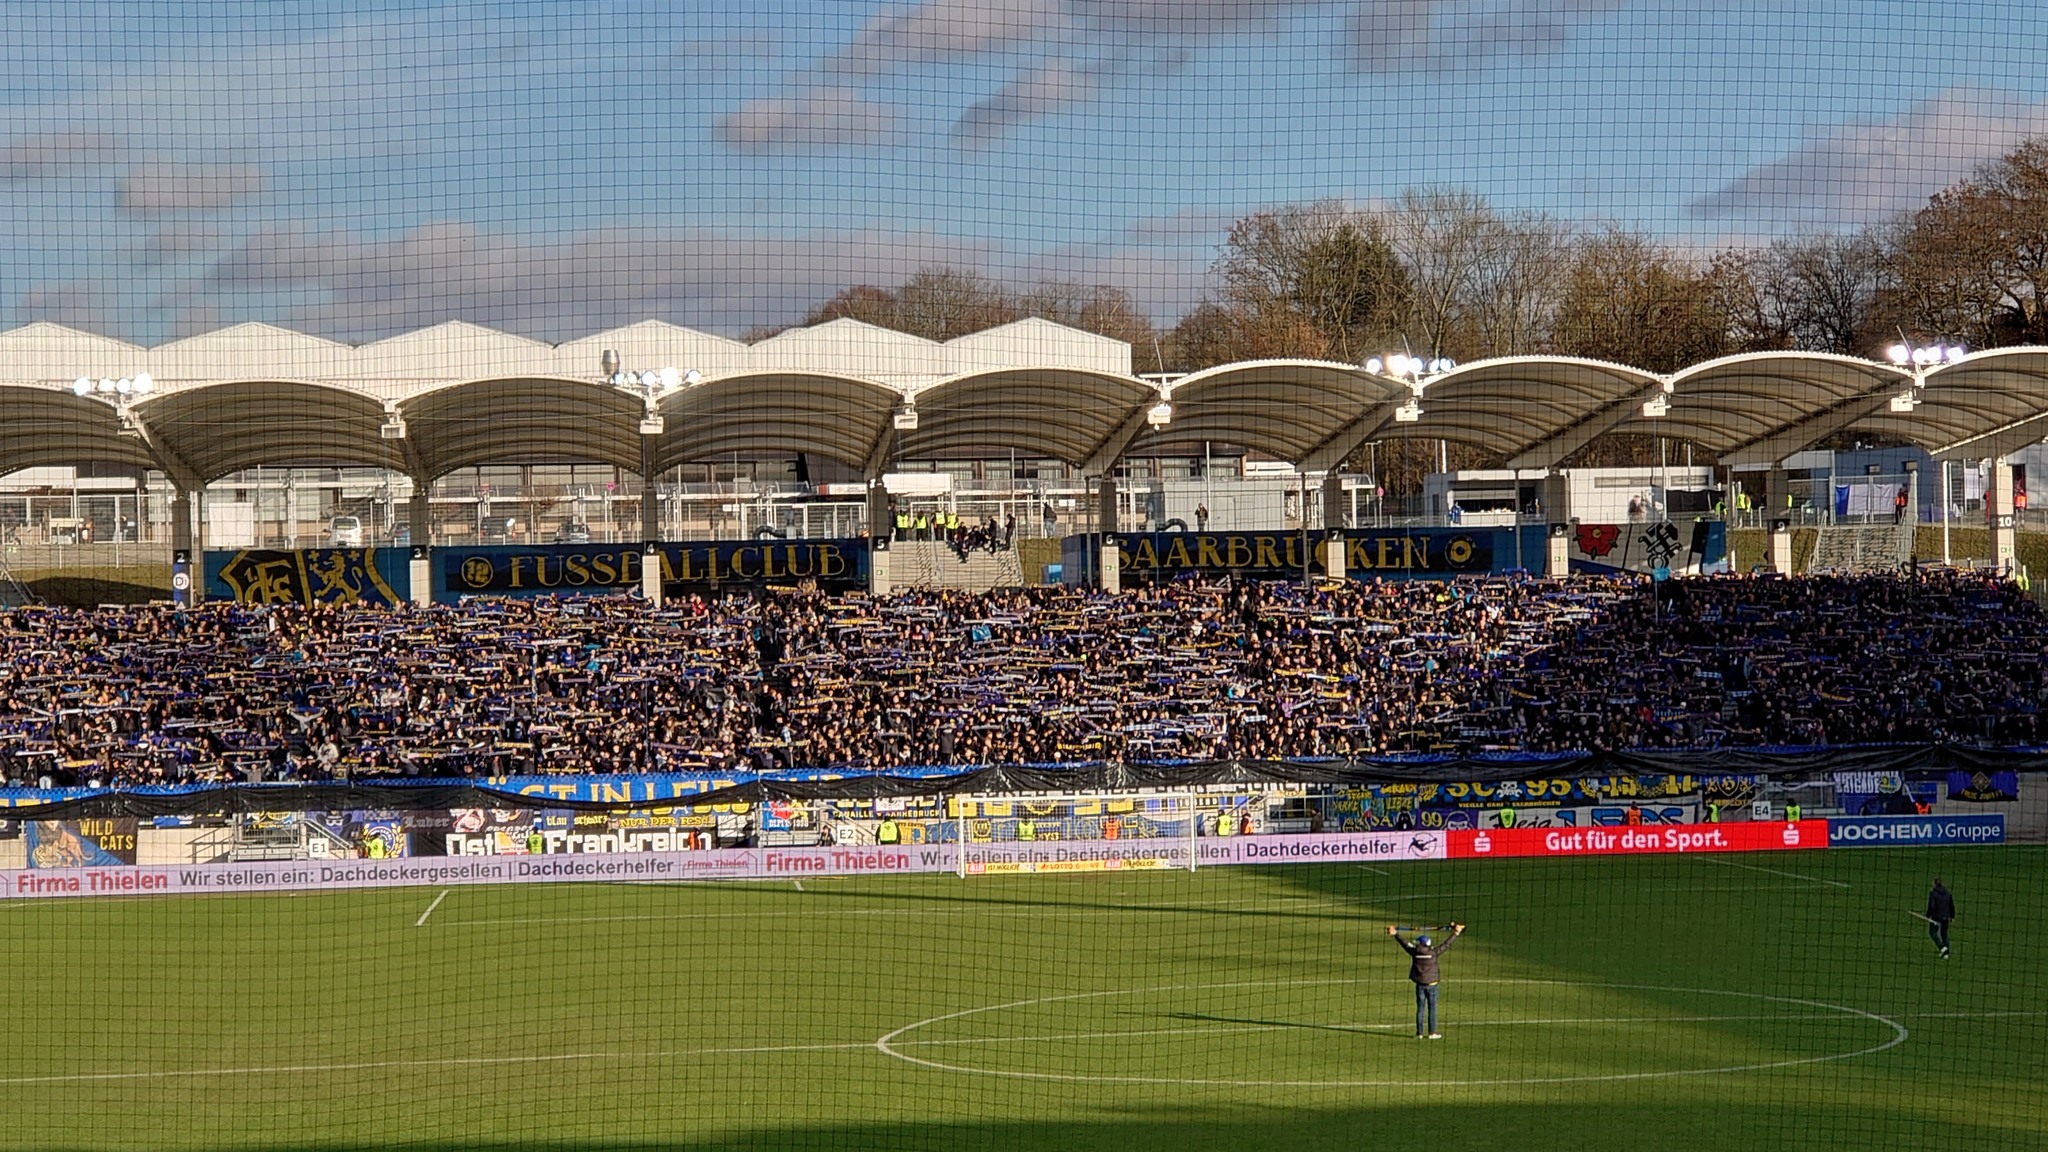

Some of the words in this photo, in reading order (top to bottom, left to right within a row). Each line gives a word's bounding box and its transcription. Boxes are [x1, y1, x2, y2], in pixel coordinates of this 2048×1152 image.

[1777, 521, 1786, 532] 9
[1998, 516, 2012, 527] 10
[1331, 530, 1340, 541] 7
[1555, 526, 1563, 536] 8
[877, 539, 885, 550] 5
[1105, 534, 1114, 545] 6
[413, 548, 422, 559] 3
[647, 543, 655, 554] 4
[176, 552, 185, 563] 2
[1755, 805, 1770, 816] E4
[620, 817, 647, 828] NUR
[650, 816, 676, 827] DER
[1421, 811, 1443, 828] 99
[79, 820, 113, 837] WILD
[1830, 823, 1933, 841] JOCHEM
[1945, 822, 2001, 842] Gruppe
[839, 829, 854, 840] E2
[99, 834, 134, 851] CATS
[445, 832, 495, 858] Ost
[1545, 832, 1583, 851] Gut
[1586, 831, 1617, 850] für
[1621, 830, 1660, 849] den
[1664, 829, 1728, 852] Sport.
[312, 842, 327, 853] E1
[1246, 838, 1398, 858] Dachdeckerhelfer
[920, 850, 950, 866] Wr
[1017, 848, 1050, 864] ein:
[1056, 843, 1231, 863] Dachdeckergesllen
[687, 860, 713, 869] Firma
[715, 858, 748, 869] Thielen
[766, 853, 825, 872] Firma
[831, 849, 910, 870] Thielen
[518, 858, 674, 877] Dachdeckerhelfer
[179, 870, 211, 886] Wir
[216, 869, 276, 886] stellen
[281, 868, 315, 884] ein:
[320, 863, 501, 883] Dachdeckergesellen
[17, 874, 80, 893] Firma
[86, 870, 168, 892] Thielen
